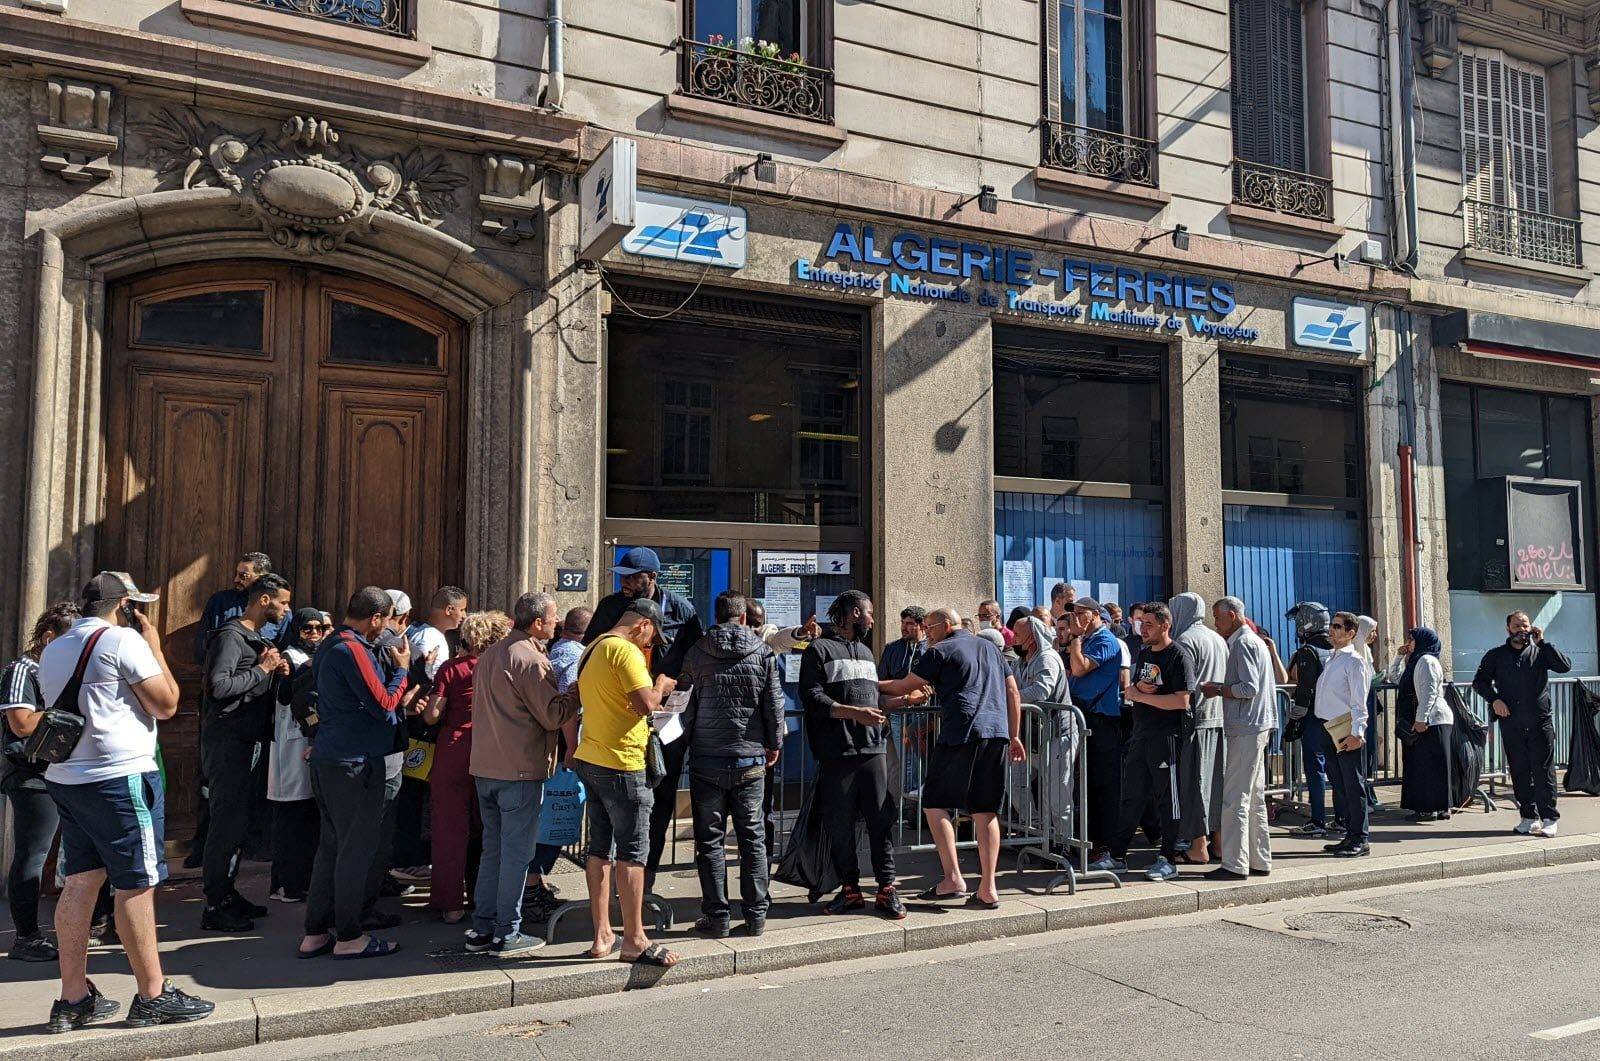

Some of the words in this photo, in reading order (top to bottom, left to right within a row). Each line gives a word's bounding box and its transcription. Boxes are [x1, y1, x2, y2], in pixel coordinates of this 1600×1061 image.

[797, 258, 882, 291] Entreprise
[890, 272, 971, 303] Nationale
[978, 289, 1000, 308] de
[1006, 289, 1083, 318] Transports
[1091, 302, 1161, 327] Maritimes
[1167, 312, 1183, 330] de
[1192, 314, 1260, 340] Voyageurs
[563, 573, 583, 587] 37
